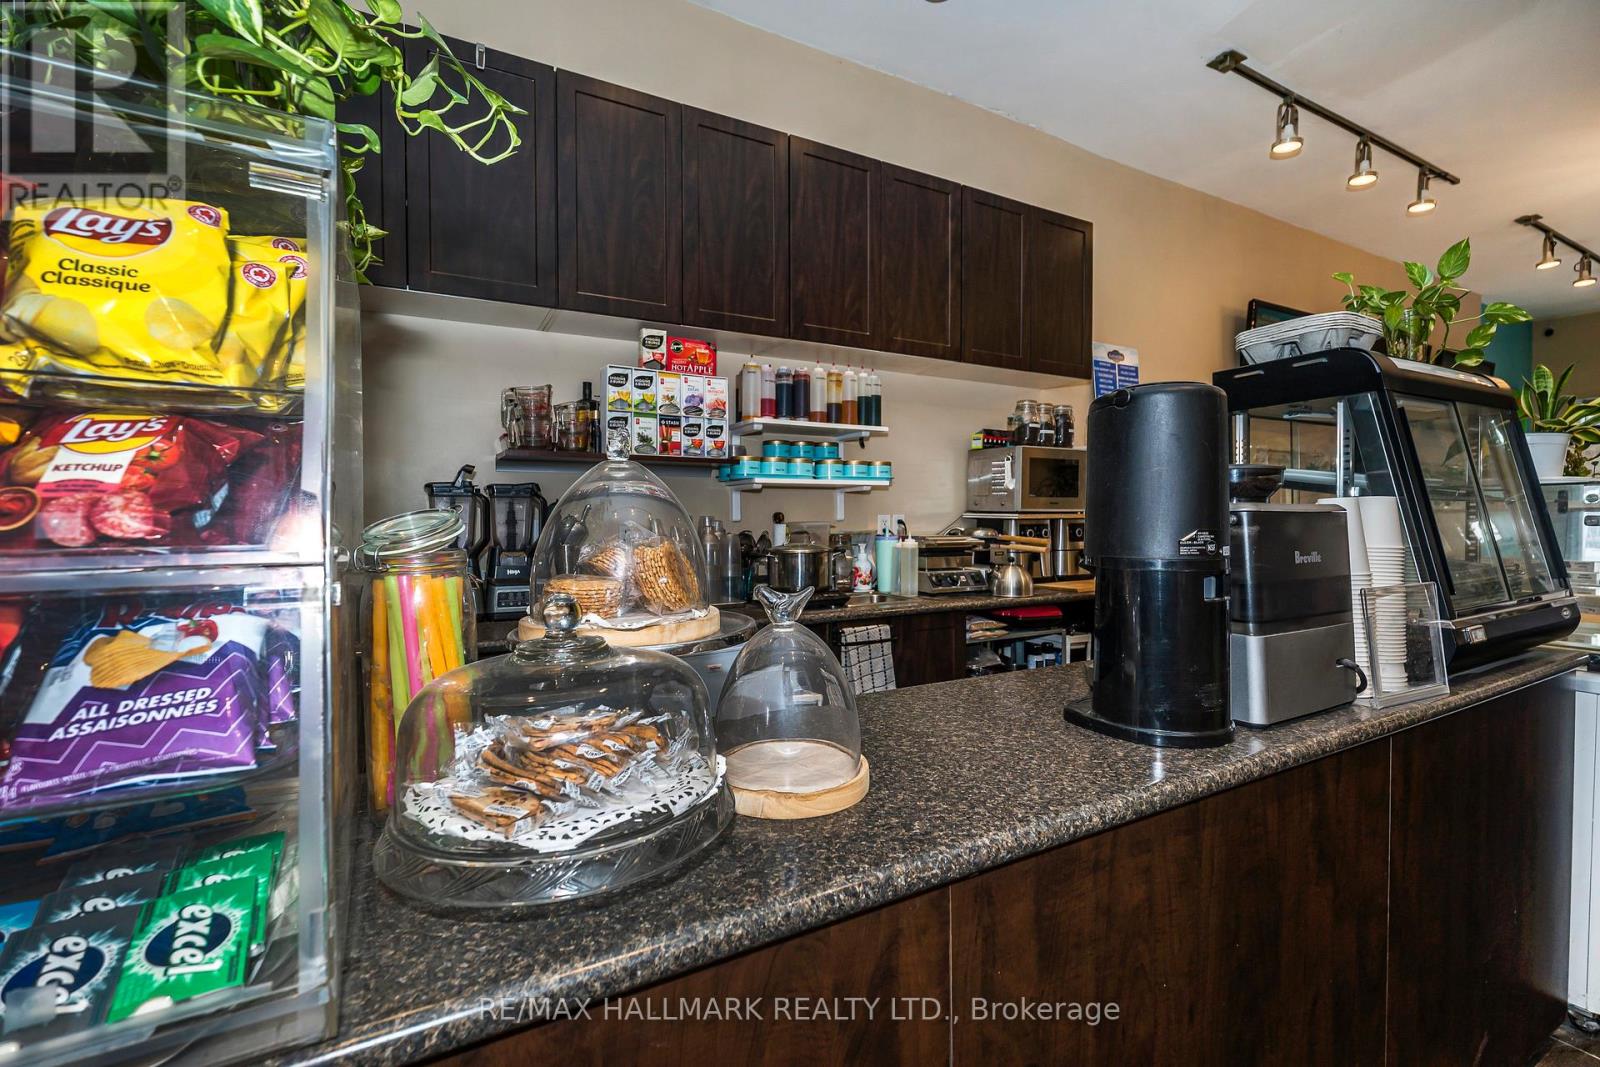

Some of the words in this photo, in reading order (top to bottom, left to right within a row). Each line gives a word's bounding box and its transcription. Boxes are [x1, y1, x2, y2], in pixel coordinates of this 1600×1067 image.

[48, 208, 163, 244] Lay's
[58, 257, 139, 279] Classic
[41, 270, 152, 294] Classique
[671, 364, 687, 372] HOT
[687, 364, 713, 375] APPLE
[60, 417, 168, 444] Lay's
[51, 463, 124, 473] KETCHUP
[1294, 551, 1322, 564] Breville
[71, 704, 110, 722] ALL
[117, 687, 212, 713] DRESSED
[48, 699, 218, 742] ASSAISONNÉES
[168, 904, 223, 976] excel
